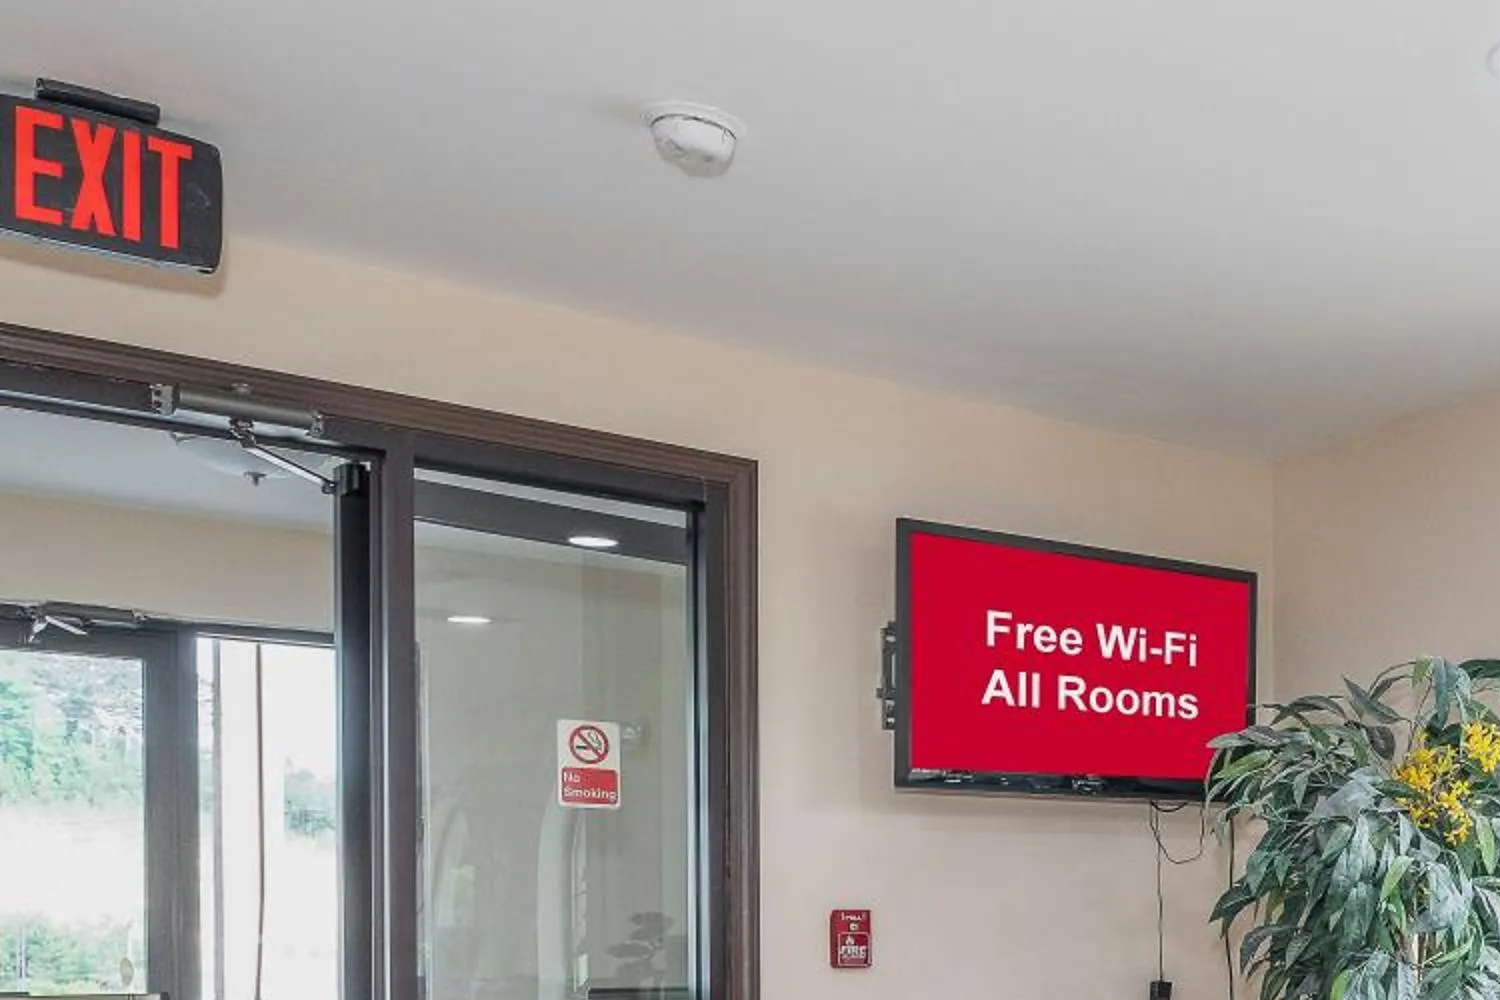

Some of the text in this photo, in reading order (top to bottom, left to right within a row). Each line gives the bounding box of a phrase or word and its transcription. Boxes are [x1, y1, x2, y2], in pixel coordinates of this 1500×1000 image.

[15, 105, 193, 249] EXIT
[986, 609, 1198, 668] Free Wi-Fi
[981, 668, 1200, 720] All Rooms
[563, 771, 581, 783] No
[563, 786, 617, 802] Smoking
